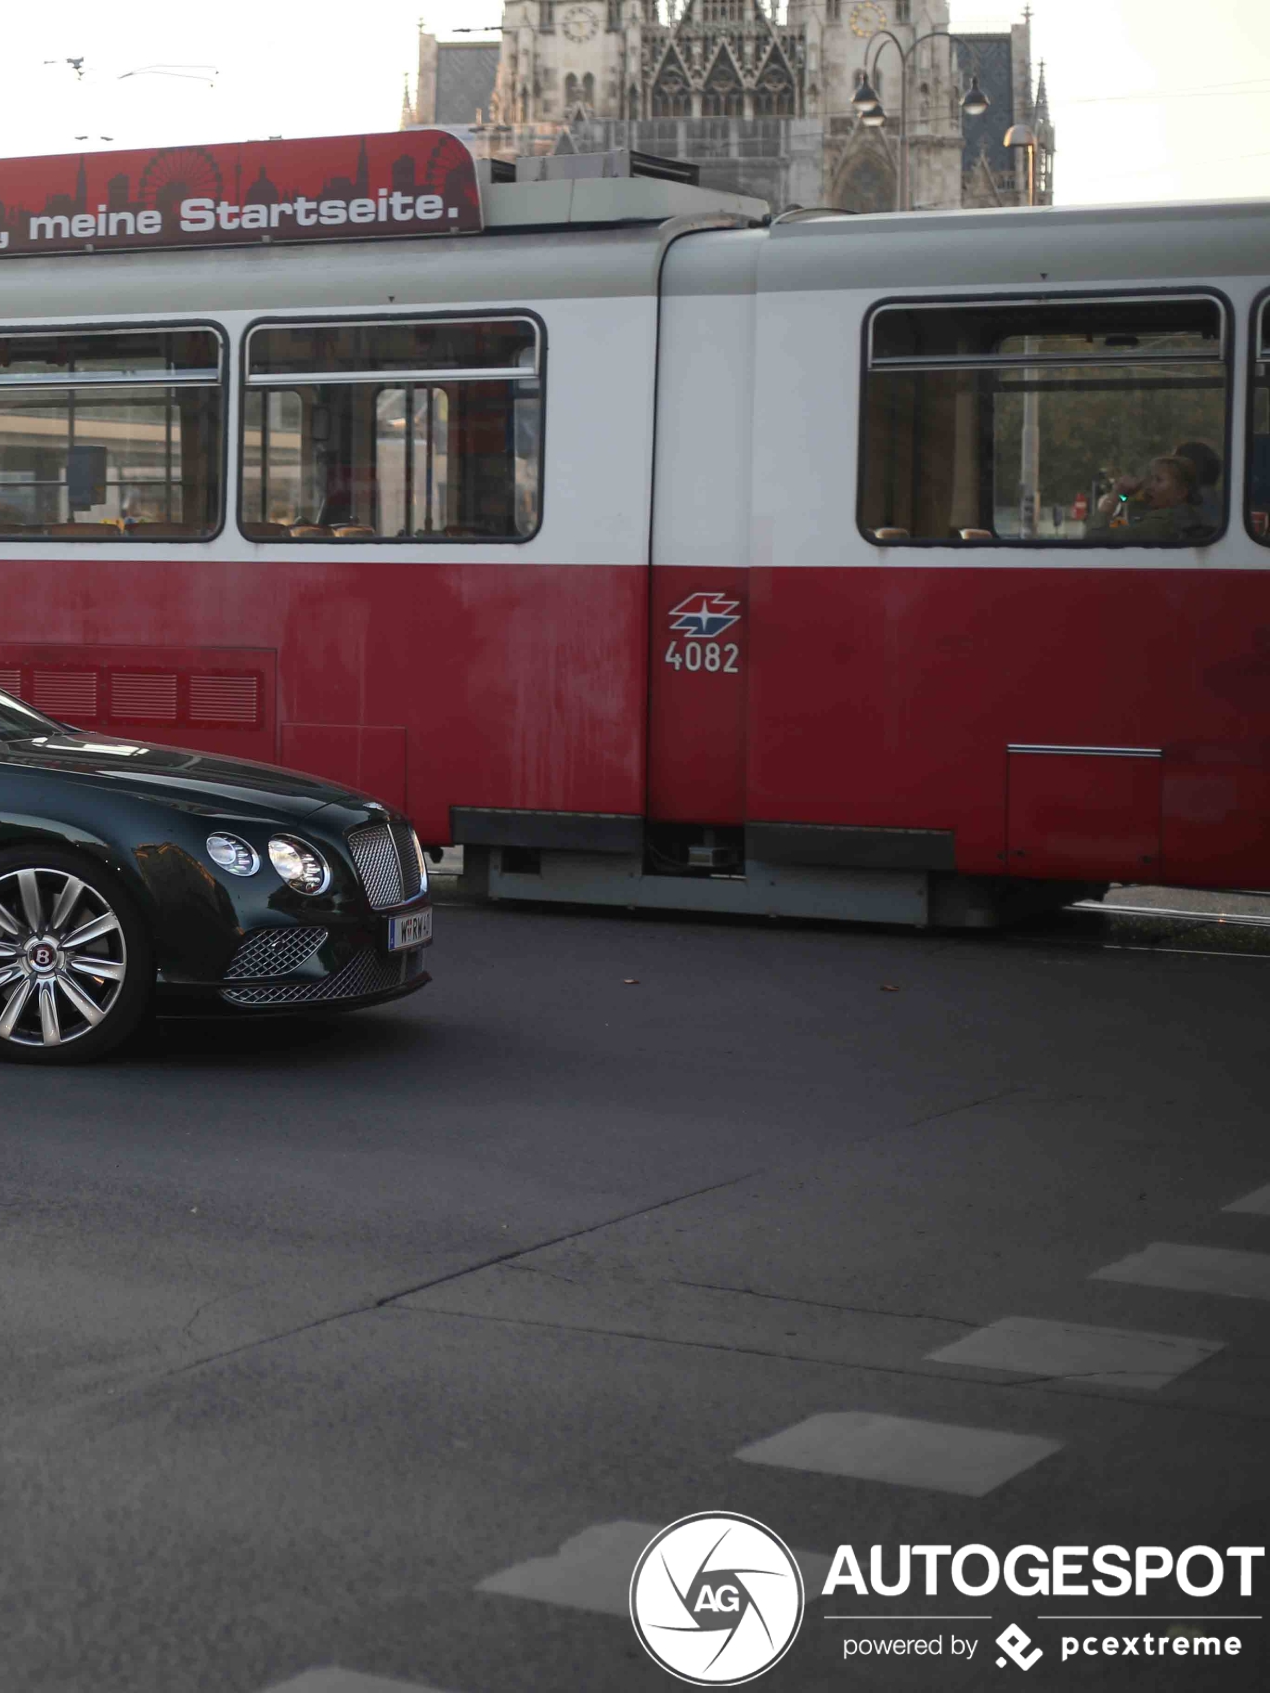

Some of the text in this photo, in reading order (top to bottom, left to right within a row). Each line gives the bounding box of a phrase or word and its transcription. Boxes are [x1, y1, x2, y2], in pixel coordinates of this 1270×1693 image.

[29, 204, 162, 240] meine
[179, 188, 459, 232] Startseite.
[664, 640, 740, 674] 4082
